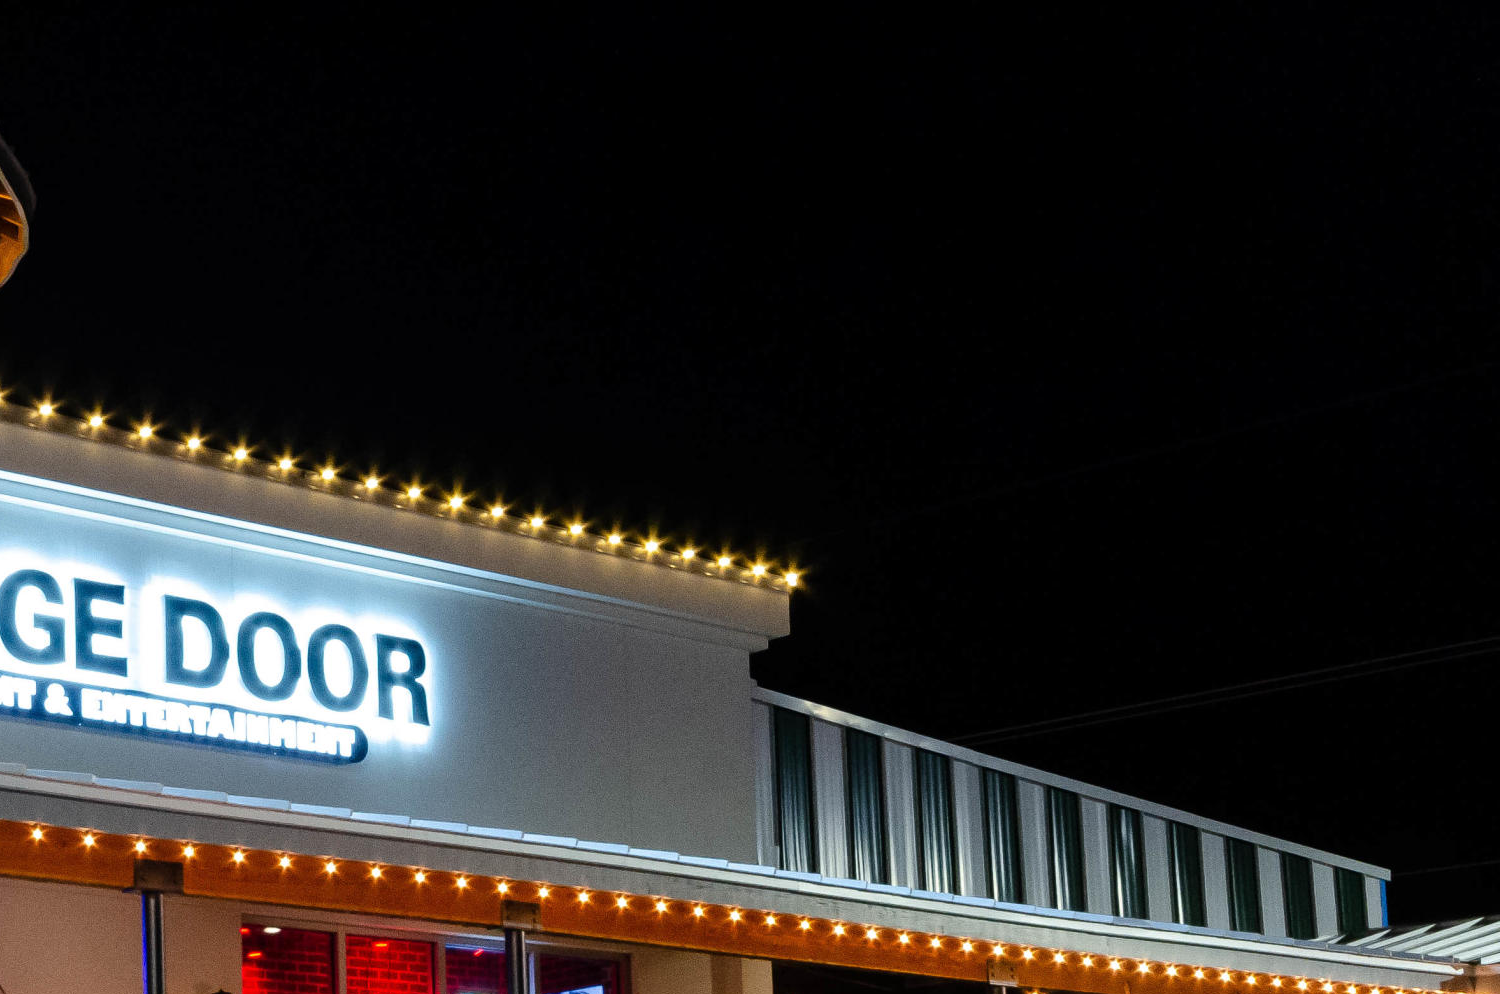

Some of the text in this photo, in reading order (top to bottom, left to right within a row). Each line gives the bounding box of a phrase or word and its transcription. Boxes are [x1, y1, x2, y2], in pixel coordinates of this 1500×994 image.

[163, 594, 431, 726] DOOR
[44, 683, 74, 716] &
[81, 688, 356, 757] ENTERTAINMENT
